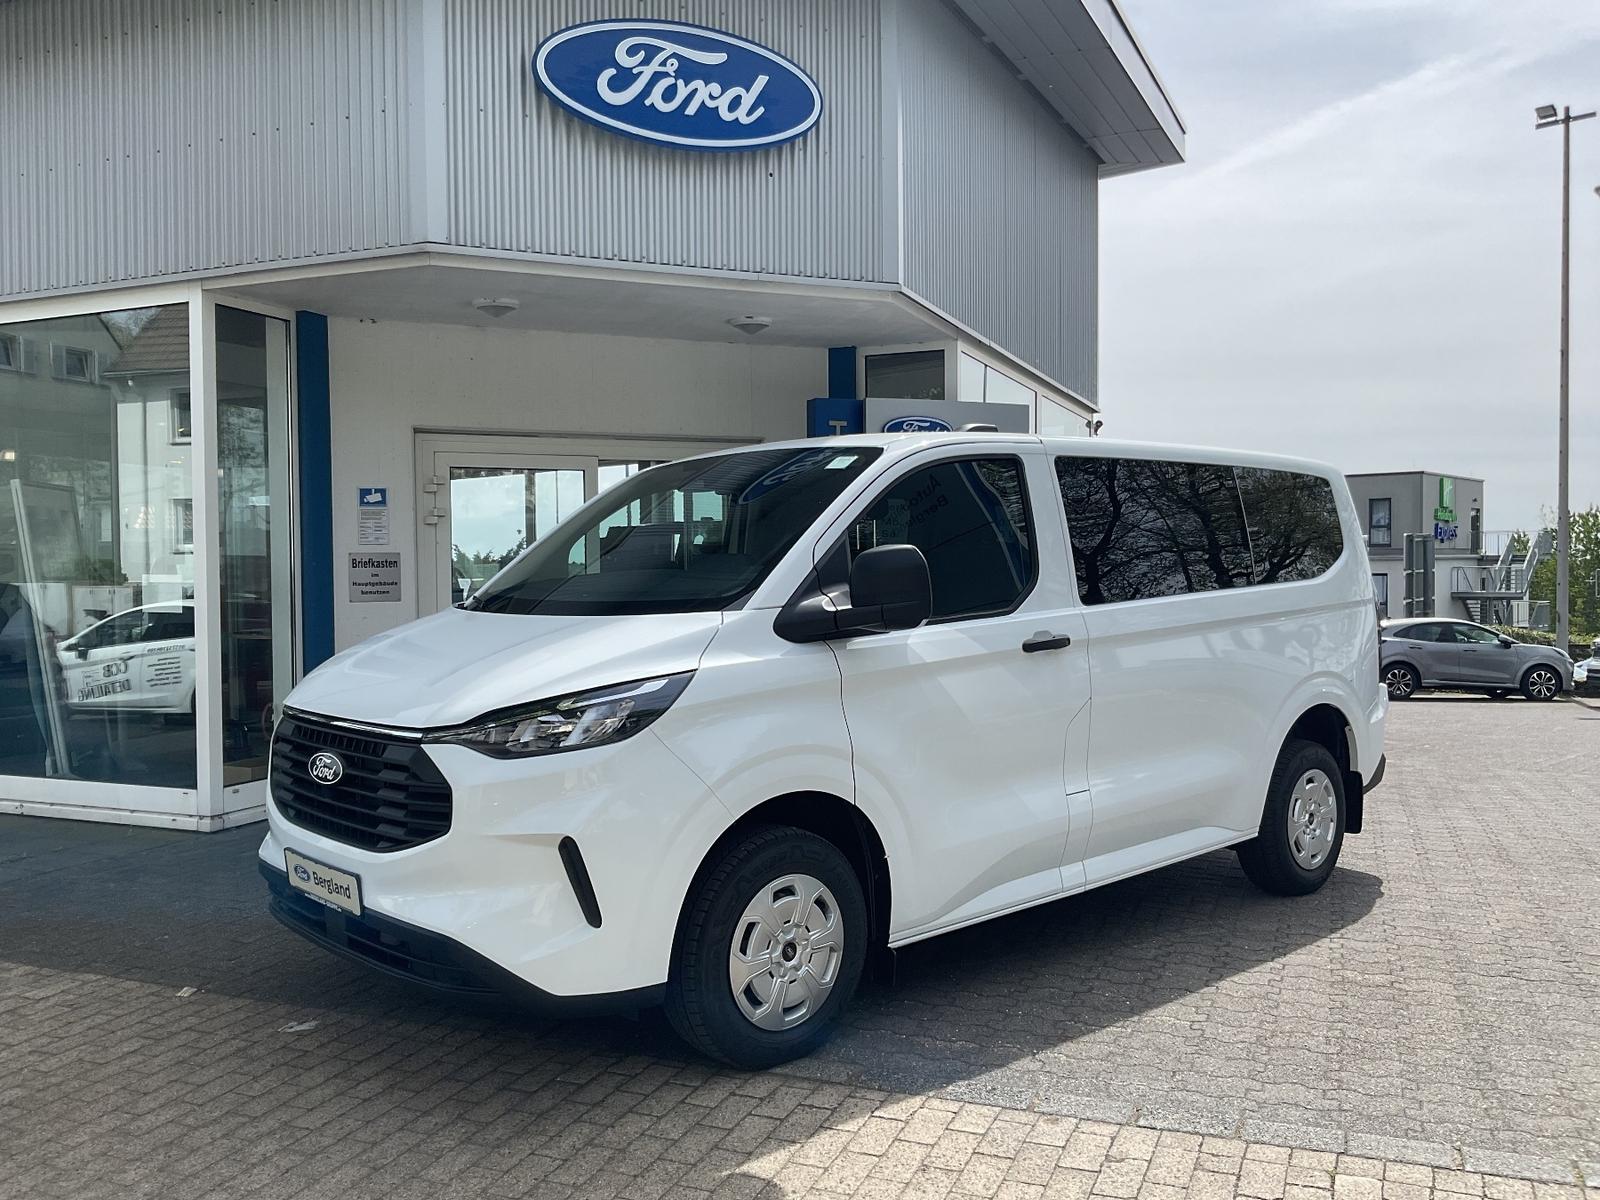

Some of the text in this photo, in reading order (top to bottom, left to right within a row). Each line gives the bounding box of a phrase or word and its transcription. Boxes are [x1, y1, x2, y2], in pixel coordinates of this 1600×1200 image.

[596, 36, 770, 125] Ford
[351, 558, 398, 568] Briefkasten
[313, 755, 337, 780] Ford
[312, 871, 351, 899] Bergland
